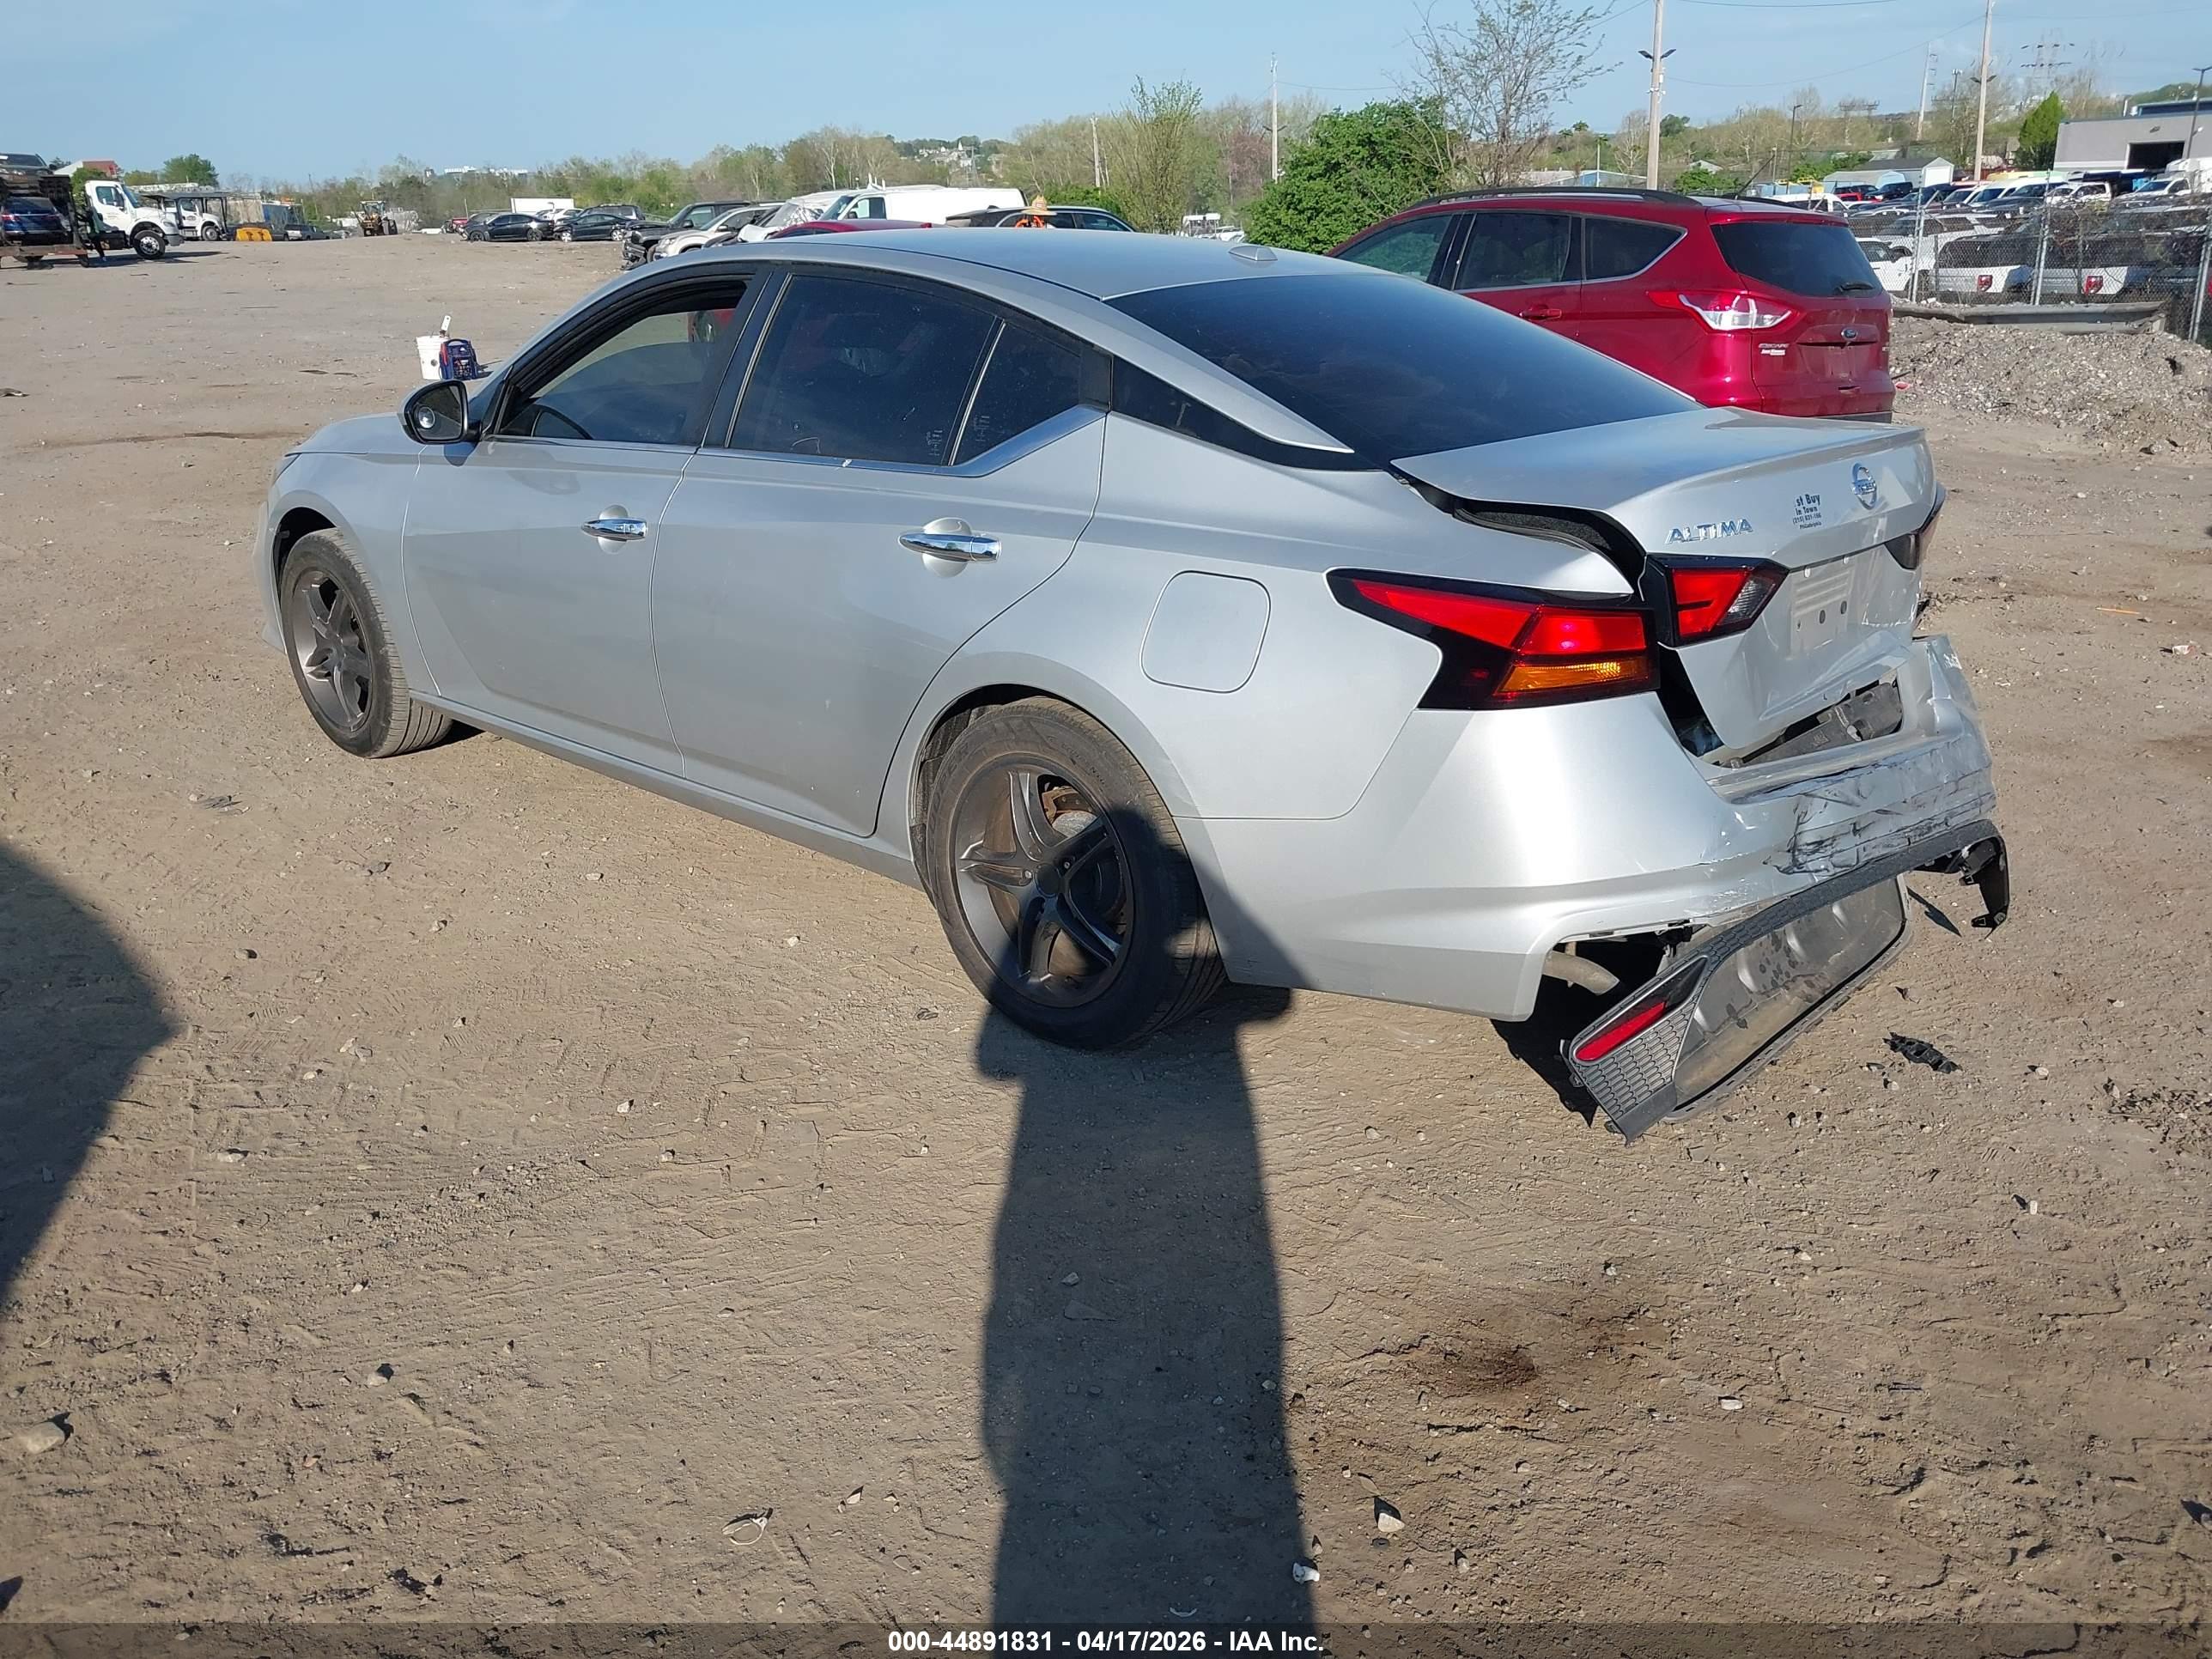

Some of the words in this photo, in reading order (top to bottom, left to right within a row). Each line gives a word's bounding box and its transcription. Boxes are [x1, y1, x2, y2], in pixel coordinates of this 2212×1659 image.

[1804, 494, 1821, 506] Buy
[1802, 507, 1818, 515] Town
[1665, 519, 1753, 544] ALTIMA
